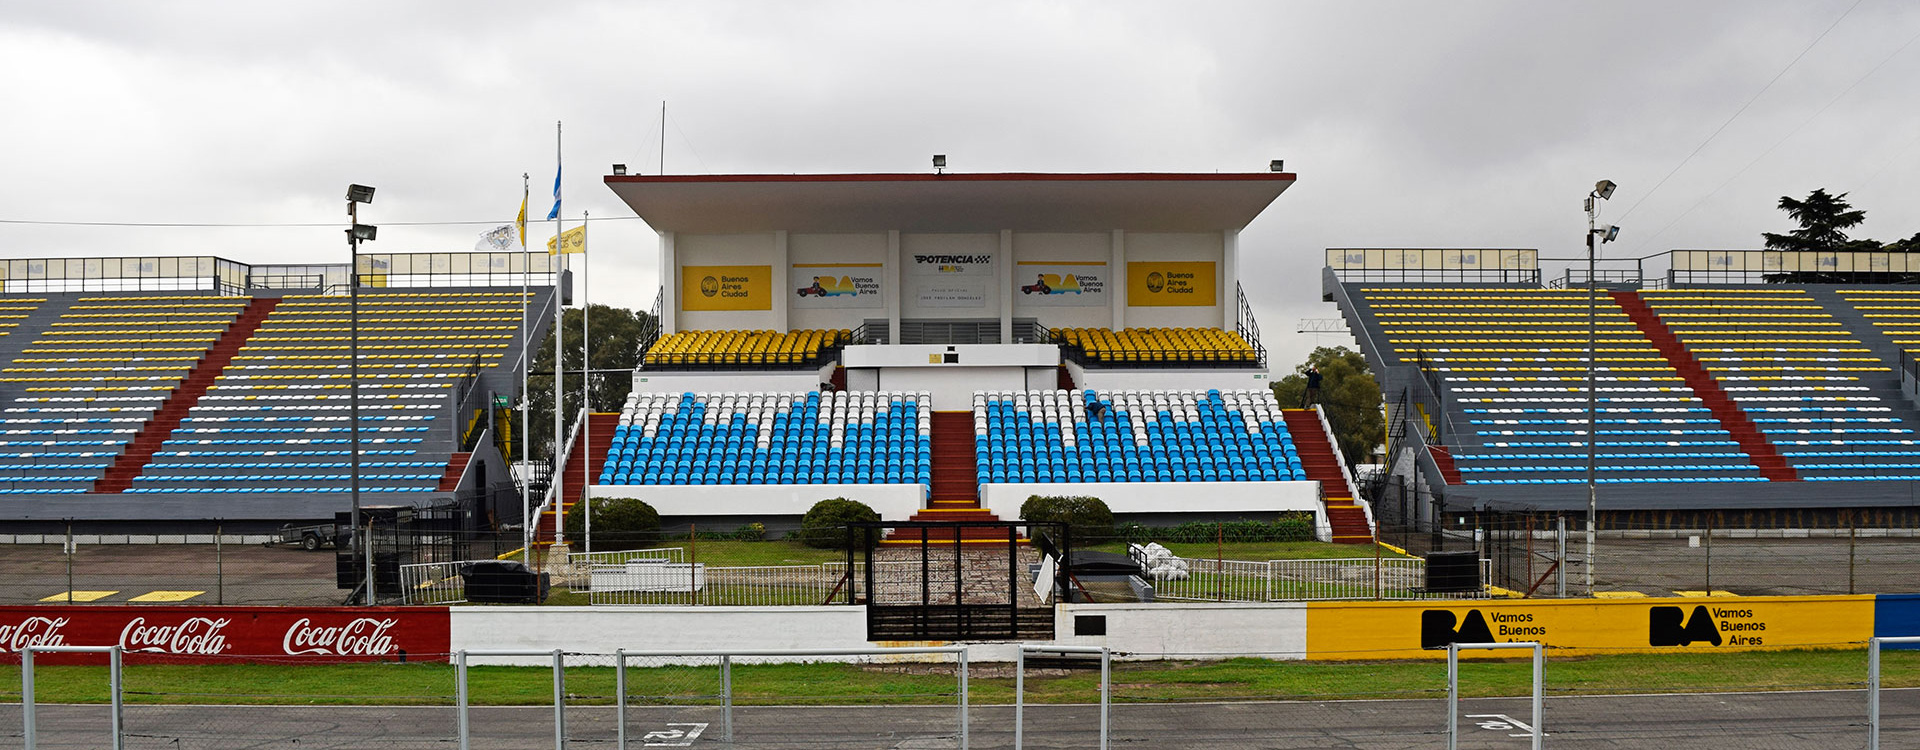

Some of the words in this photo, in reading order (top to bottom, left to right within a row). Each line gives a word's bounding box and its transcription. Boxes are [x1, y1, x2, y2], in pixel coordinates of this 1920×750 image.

[915, 255, 973, 264] POTENCIA
[1166, 271, 1194, 279] Buenos
[1490, 612, 1533, 623] Vamos
[1712, 608, 1753, 618] Vamos
[1421, 609, 1496, 650] BA
[1499, 625, 1546, 636] Buenos
[1650, 605, 1722, 647] BA
[1720, 621, 1766, 632] Buenos
[119, 617, 232, 655] Coca-Cola
[283, 618, 399, 656] Coca-Cola
[1729, 635, 1763, 646] Aires
